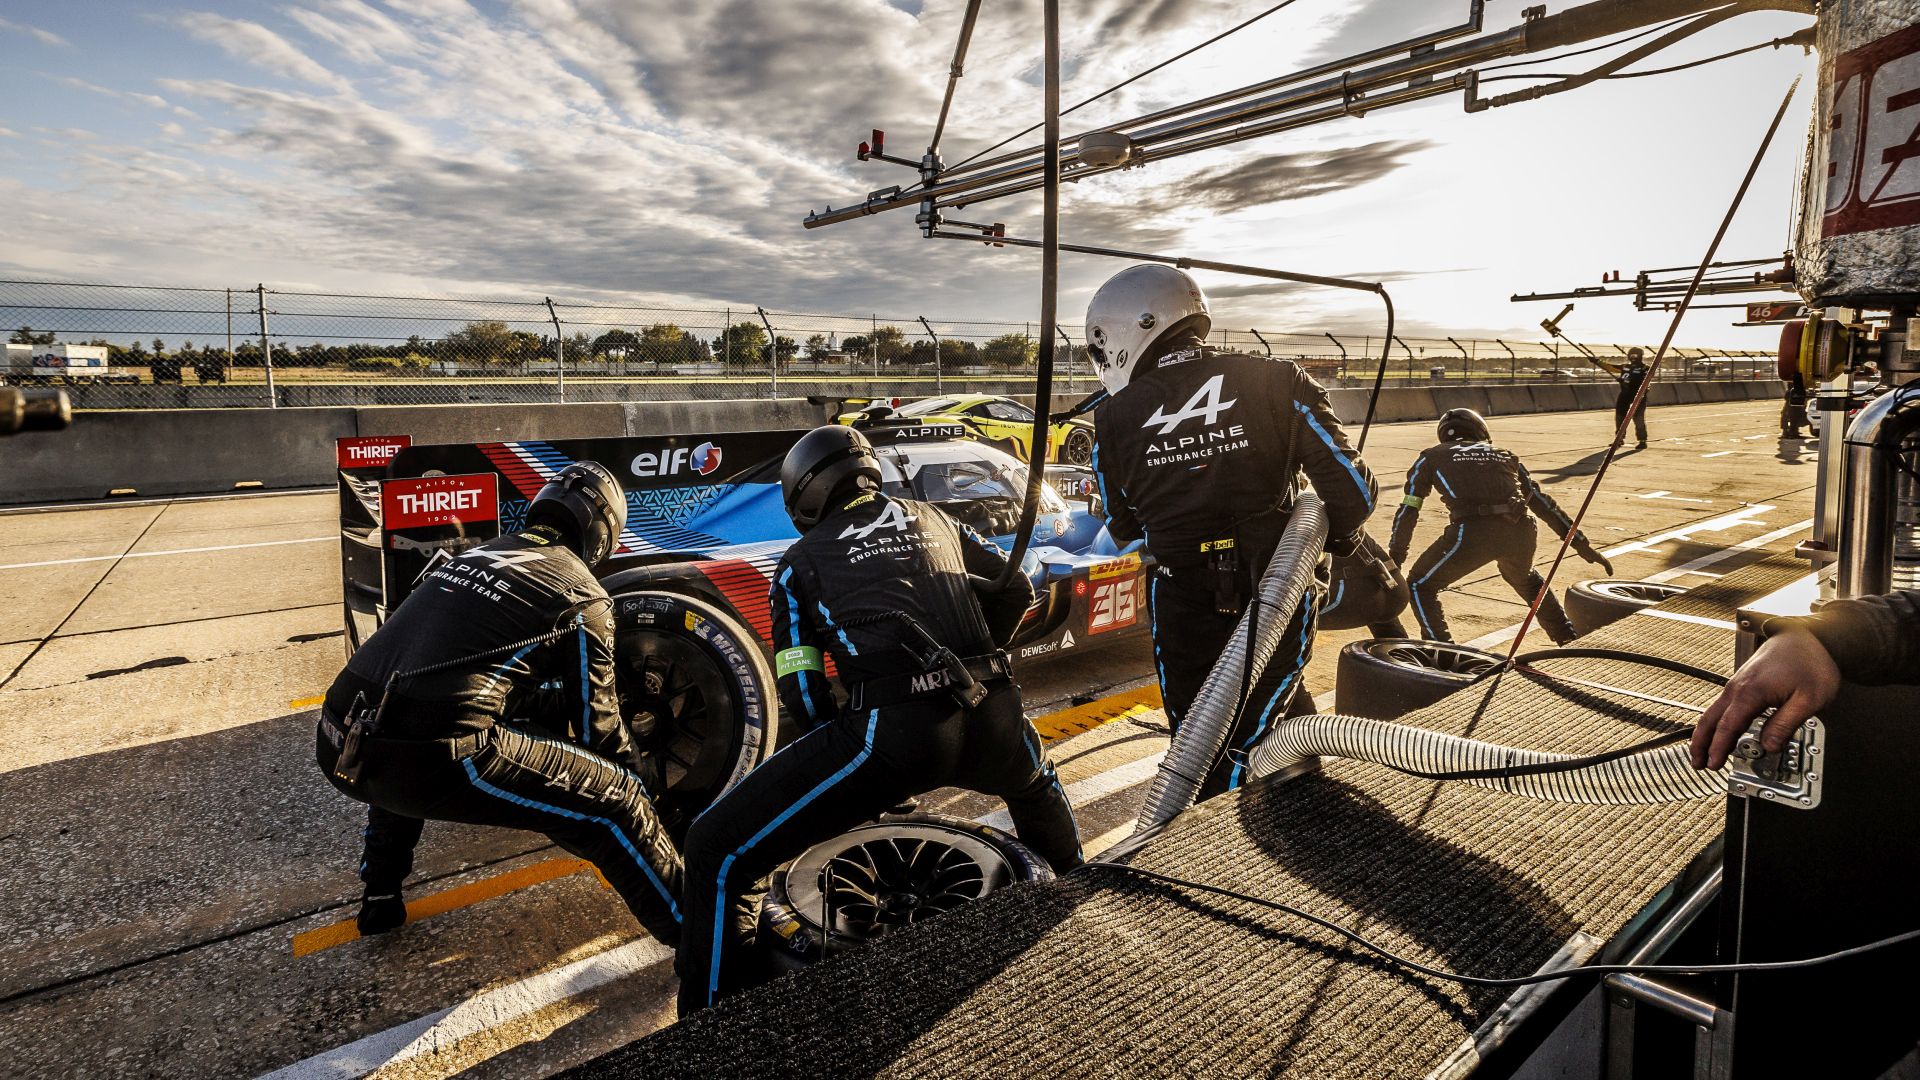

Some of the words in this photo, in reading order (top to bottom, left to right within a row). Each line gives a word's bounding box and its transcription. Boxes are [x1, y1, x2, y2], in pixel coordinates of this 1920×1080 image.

[1751, 307, 1771, 317] 46
[896, 427, 963, 438] ALPINE
[1146, 425, 1244, 454] ALPINE
[347, 445, 402, 459] THIRIET
[630, 447, 689, 477] elf
[1147, 448, 1213, 467] ENDURANCE
[1217, 439, 1249, 453] TEAM
[415, 480, 465, 490] MAISON
[396, 488, 483, 515] THIRIET
[427, 515, 456, 523] 1902
[846, 532, 935, 555] ALPINE
[850, 544, 913, 564] ENDURANCE
[916, 541, 940, 549] TEAM
[1204, 540, 1234, 551] Sbelt
[1096, 557, 1136, 574] DHL
[431, 571, 471, 587] DURANCE
[472, 583, 502, 601] TEAM
[1091, 579, 1134, 628] 36
[1021, 641, 1059, 658] DEWESoft
[711, 632, 760, 720] MICHELIN
[780, 662, 790, 670] PIT
